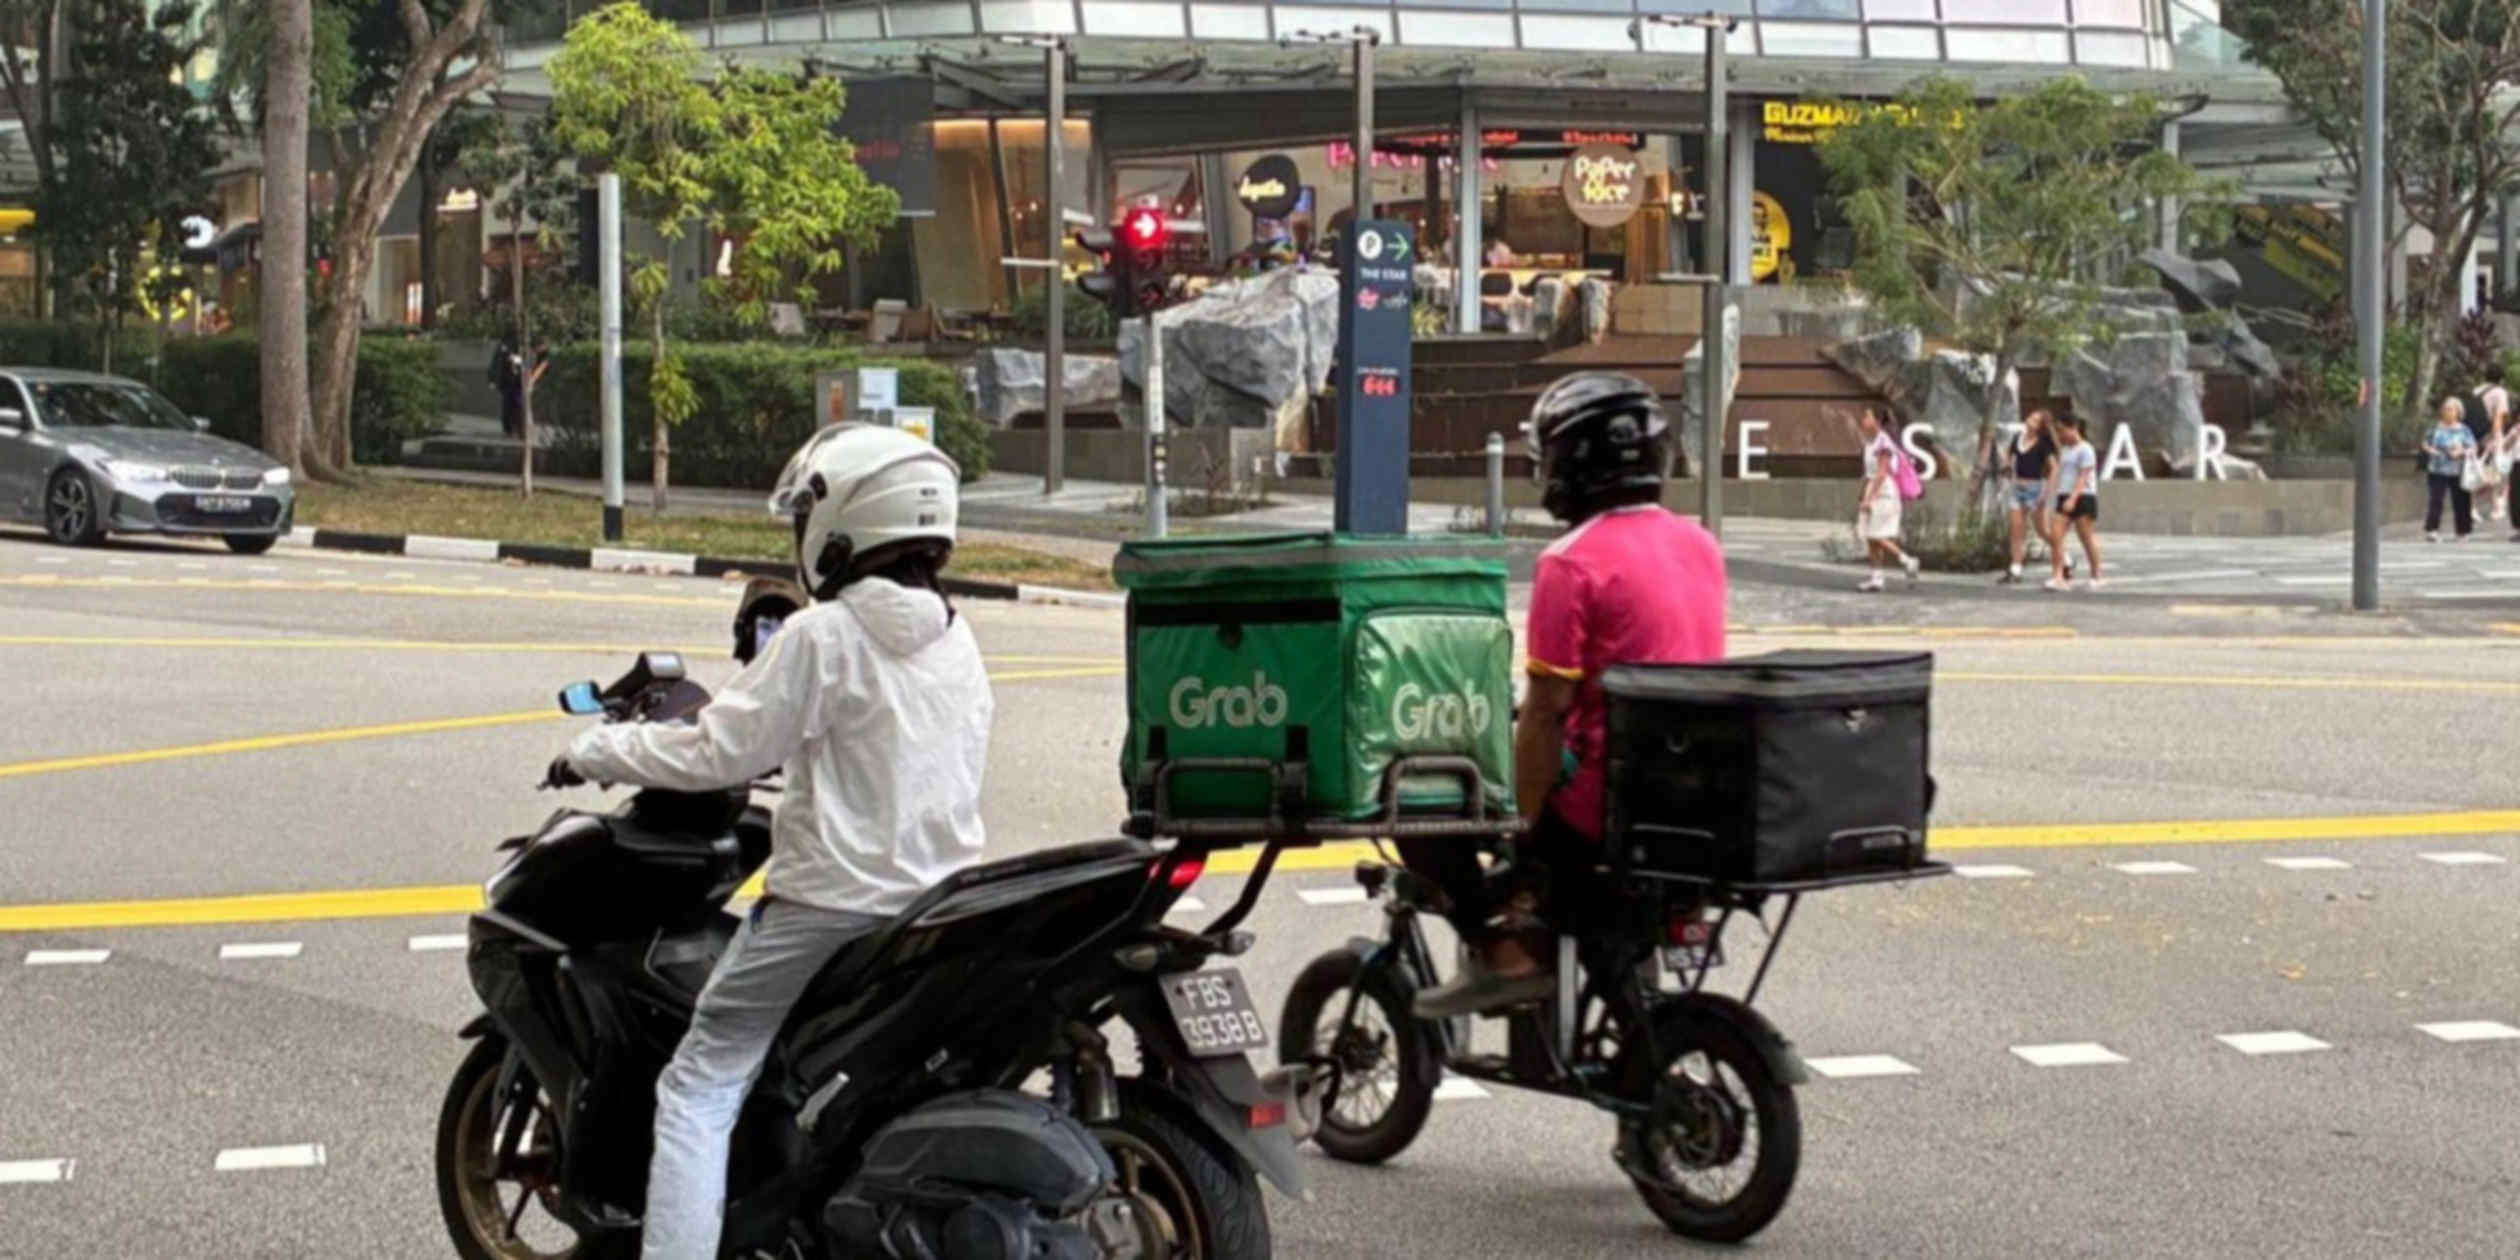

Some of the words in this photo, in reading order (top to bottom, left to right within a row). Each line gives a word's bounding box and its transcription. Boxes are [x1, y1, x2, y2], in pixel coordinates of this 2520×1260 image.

[1361, 267, 1380, 280] THE
[1169, 671, 1288, 729] Grab
[1391, 678, 1490, 741] Grab
[1182, 976, 1231, 1010] FBS
